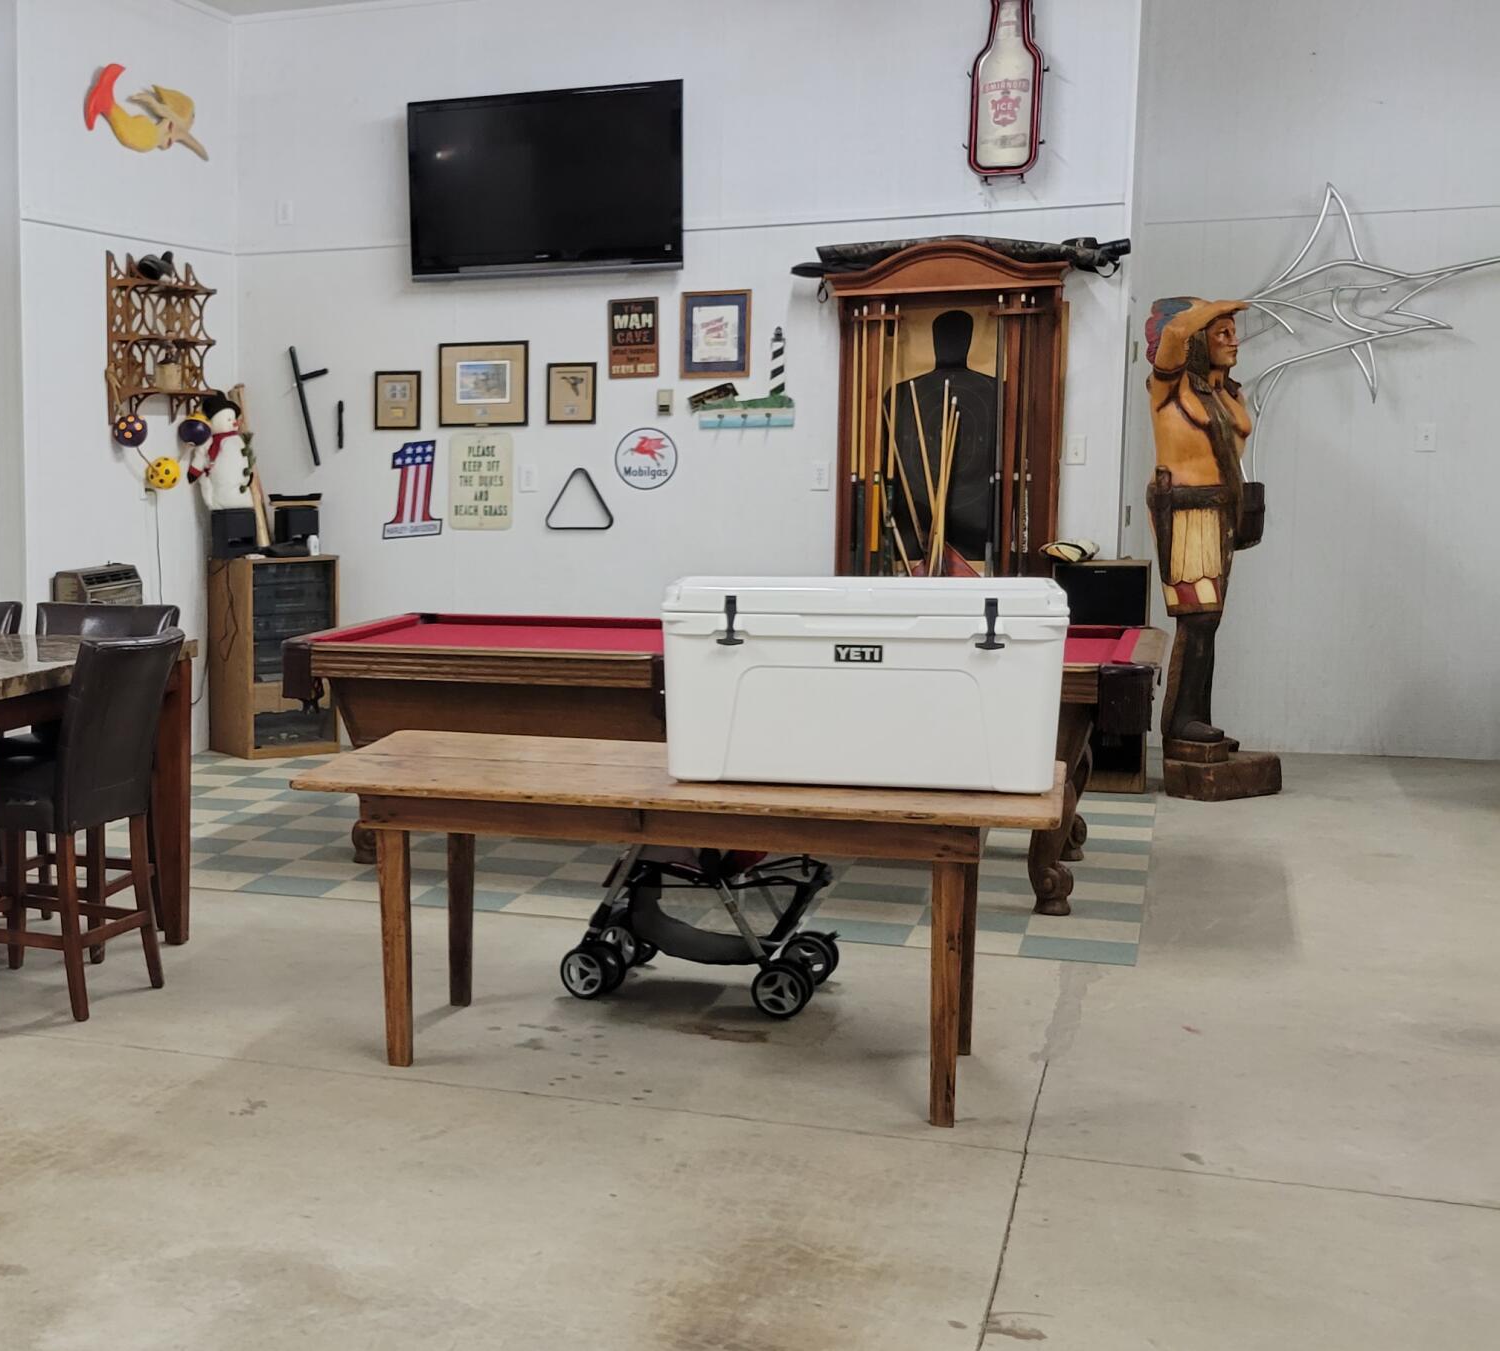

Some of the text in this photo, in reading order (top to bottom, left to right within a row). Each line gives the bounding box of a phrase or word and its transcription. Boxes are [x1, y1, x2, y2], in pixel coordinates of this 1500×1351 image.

[996, 102, 1013, 111] ICE
[613, 313, 653, 330] MAN
[616, 331, 651, 344] CAVE
[467, 445, 496, 457] PLEASE
[462, 460, 500, 472] KEEP OFF
[624, 466, 668, 480] Mobilgas
[459, 475, 473, 487] THE
[474, 490, 489, 501] AND
[454, 505, 508, 516] BEACH GRASS
[836, 647, 880, 660] YETI
